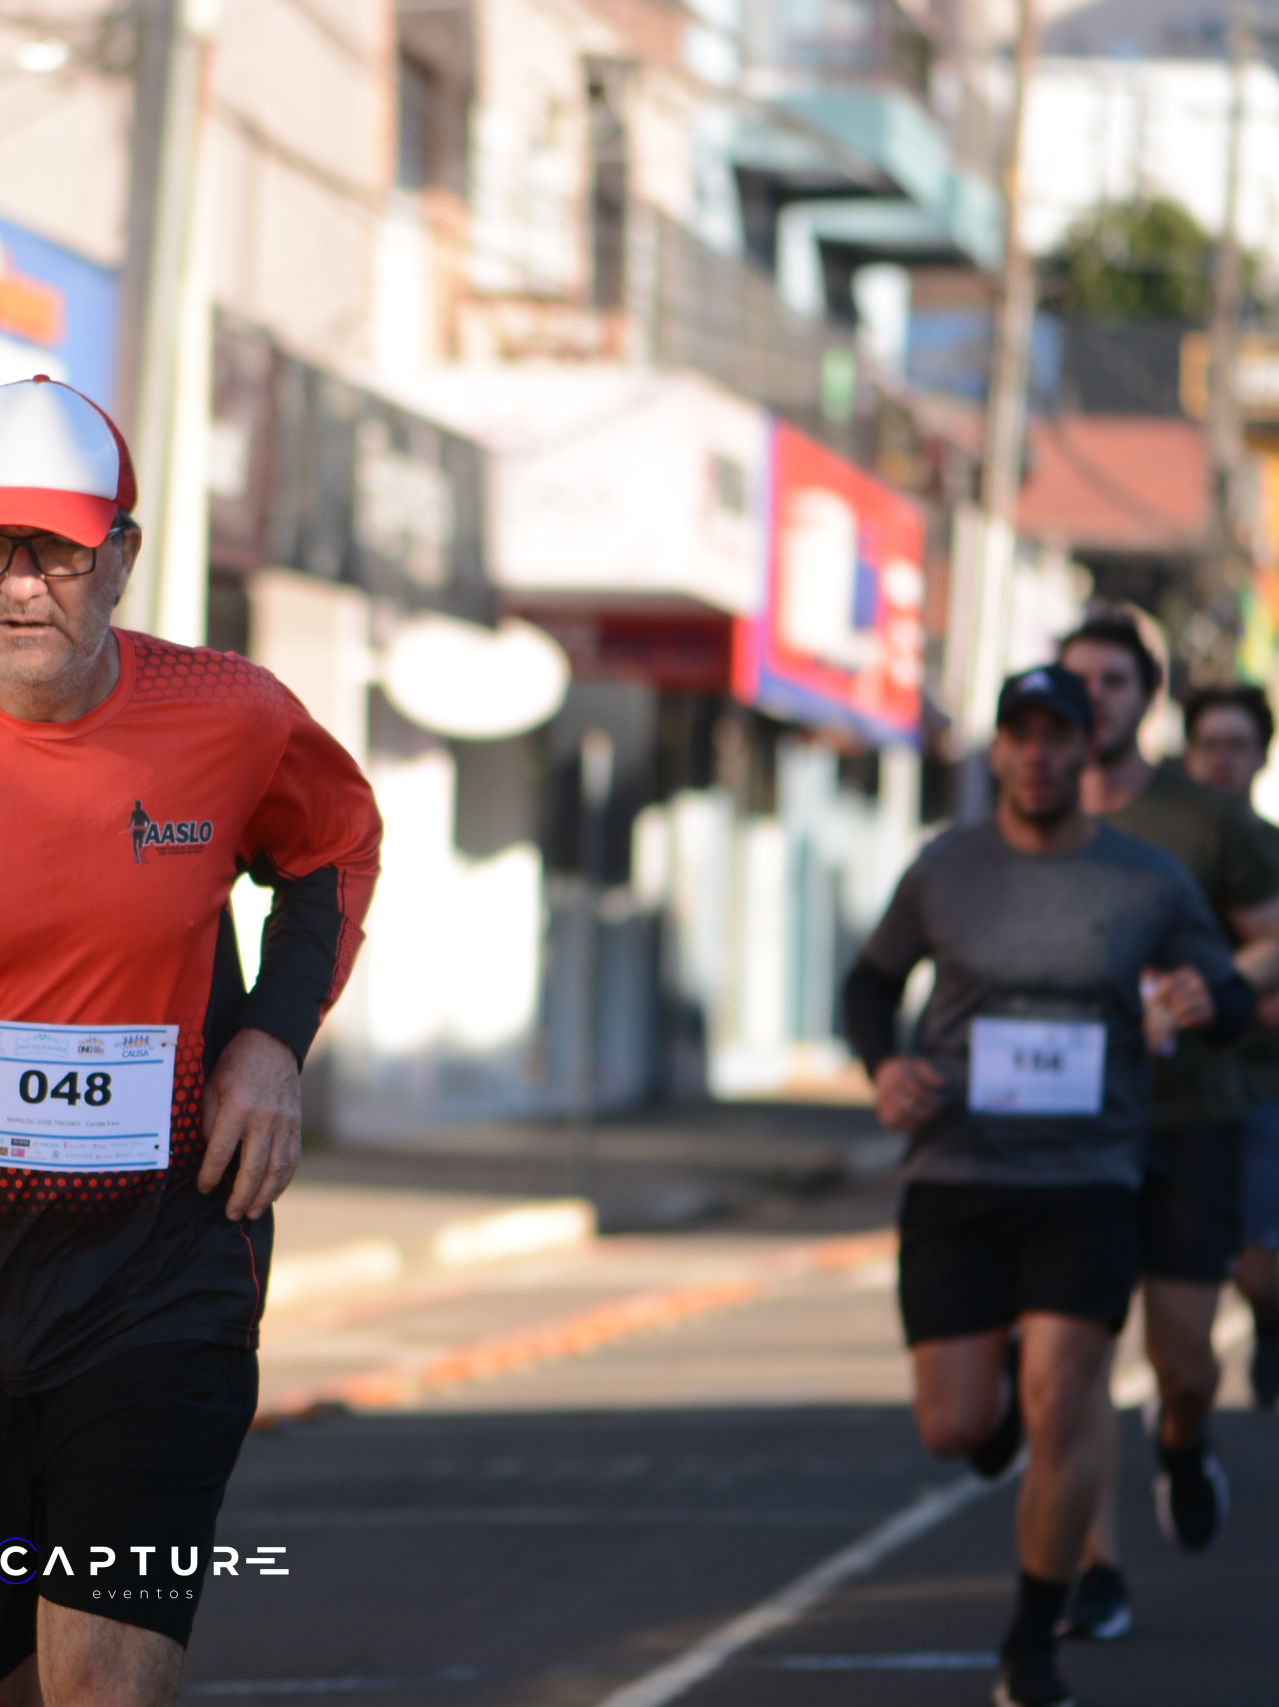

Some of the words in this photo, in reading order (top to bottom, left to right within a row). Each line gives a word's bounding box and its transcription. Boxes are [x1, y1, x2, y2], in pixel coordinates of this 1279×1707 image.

[143, 820, 214, 847] AASLO
[122, 1050, 149, 1058] CAUSA
[19, 1070, 112, 1107] 048
